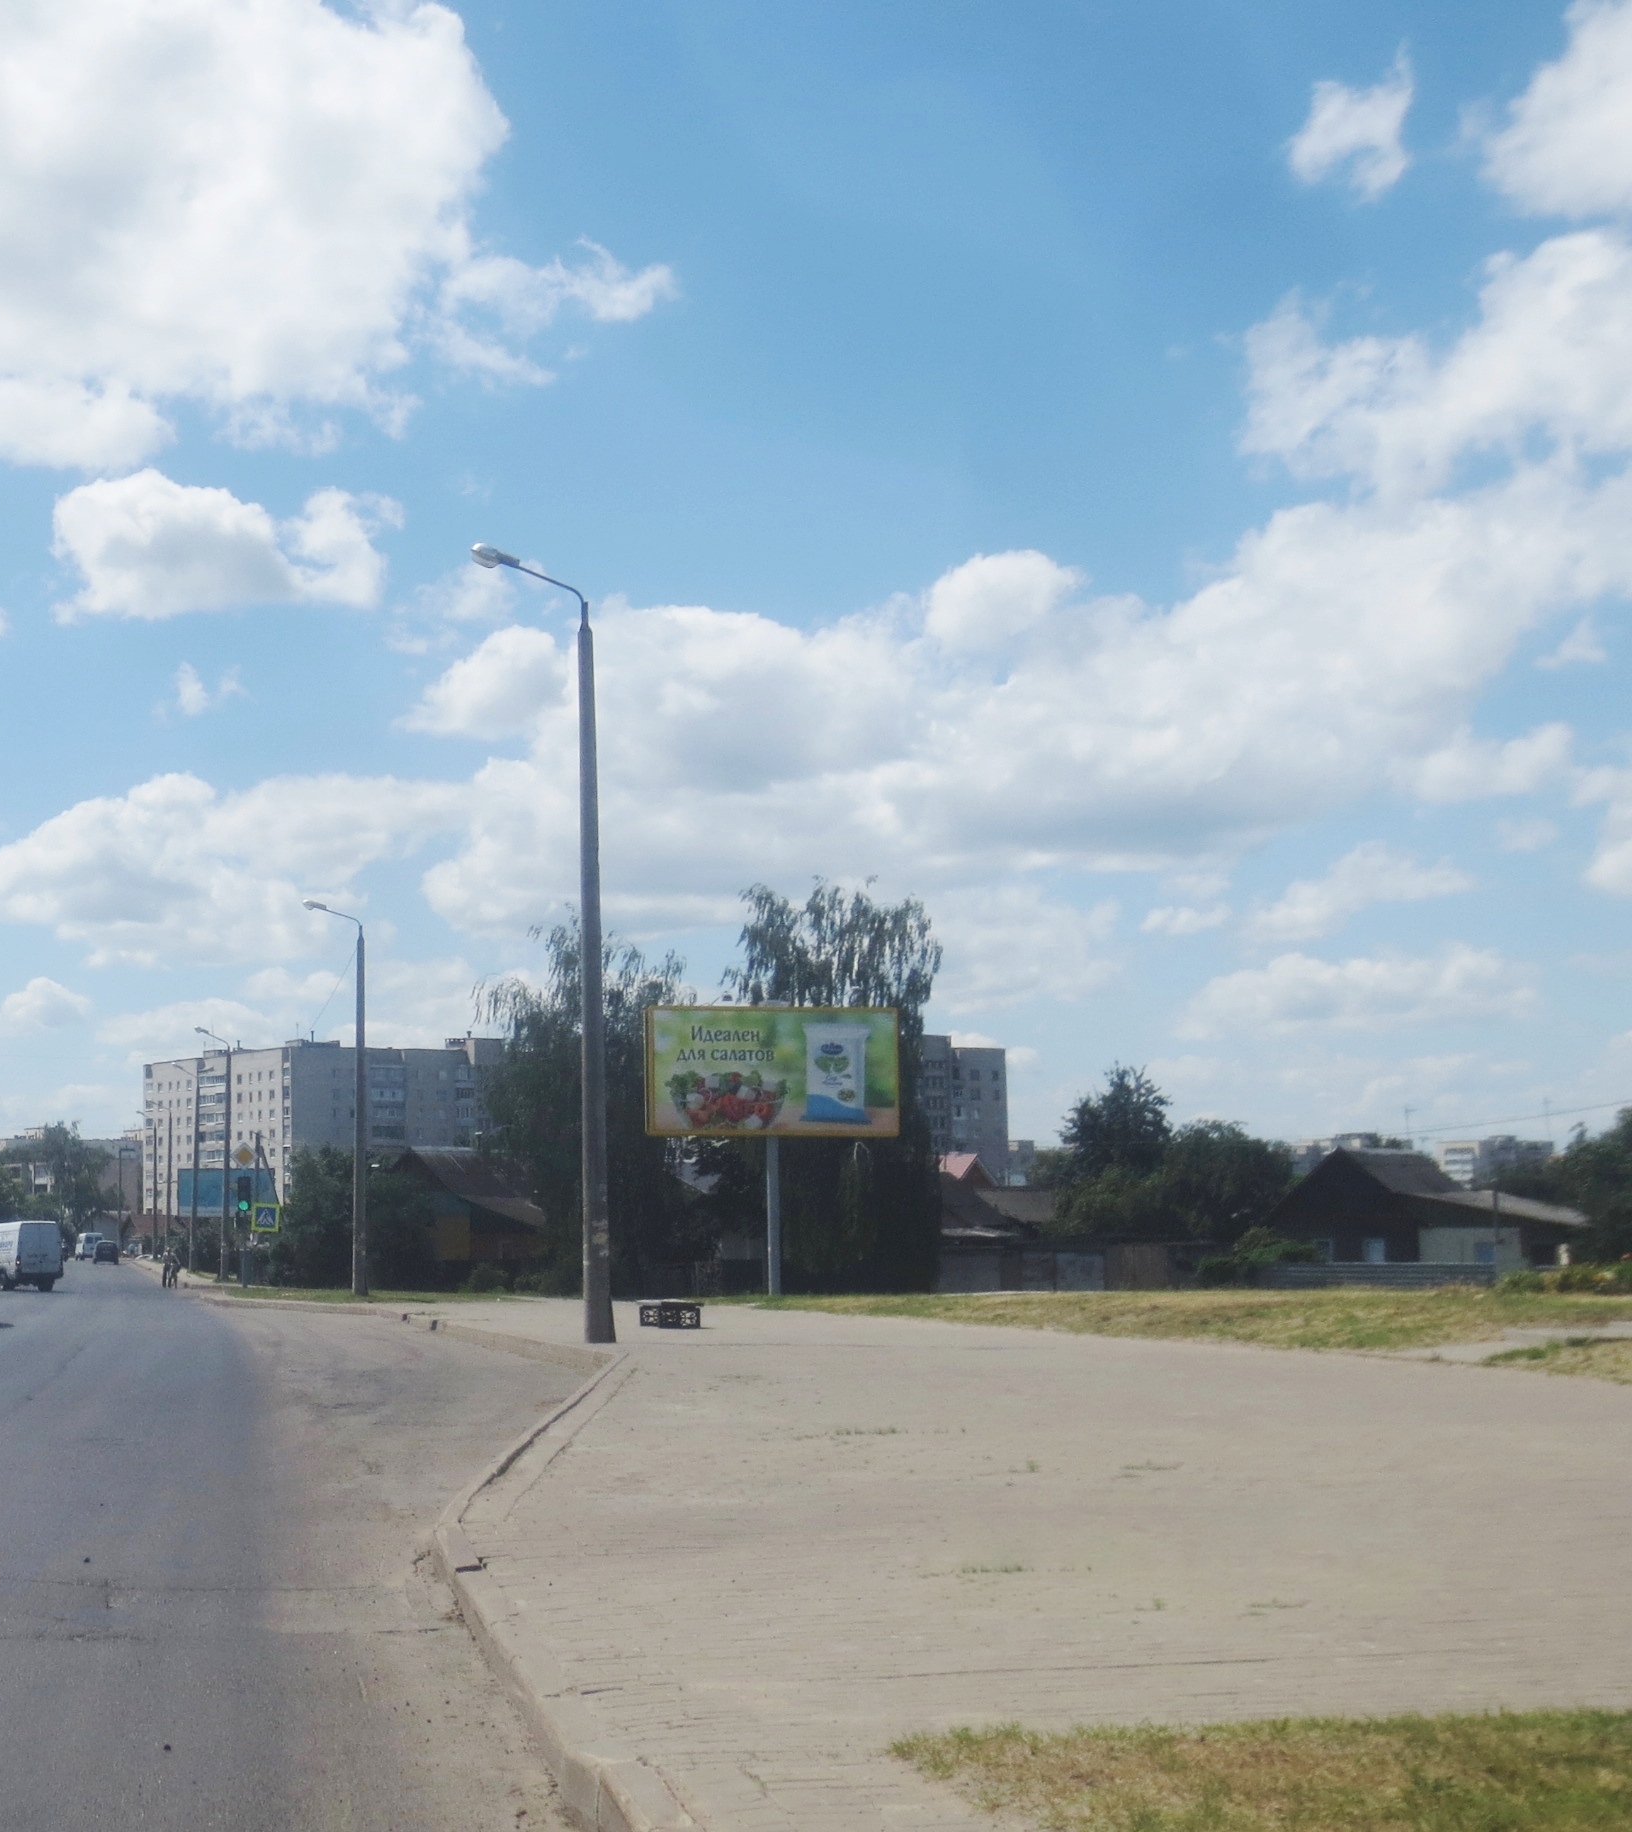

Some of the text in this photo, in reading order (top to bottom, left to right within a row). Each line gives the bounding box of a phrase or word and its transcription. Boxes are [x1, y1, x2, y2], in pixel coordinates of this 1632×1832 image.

[691, 1025, 760, 1043] Идеален
[676, 1048, 775, 1062] для салатов
